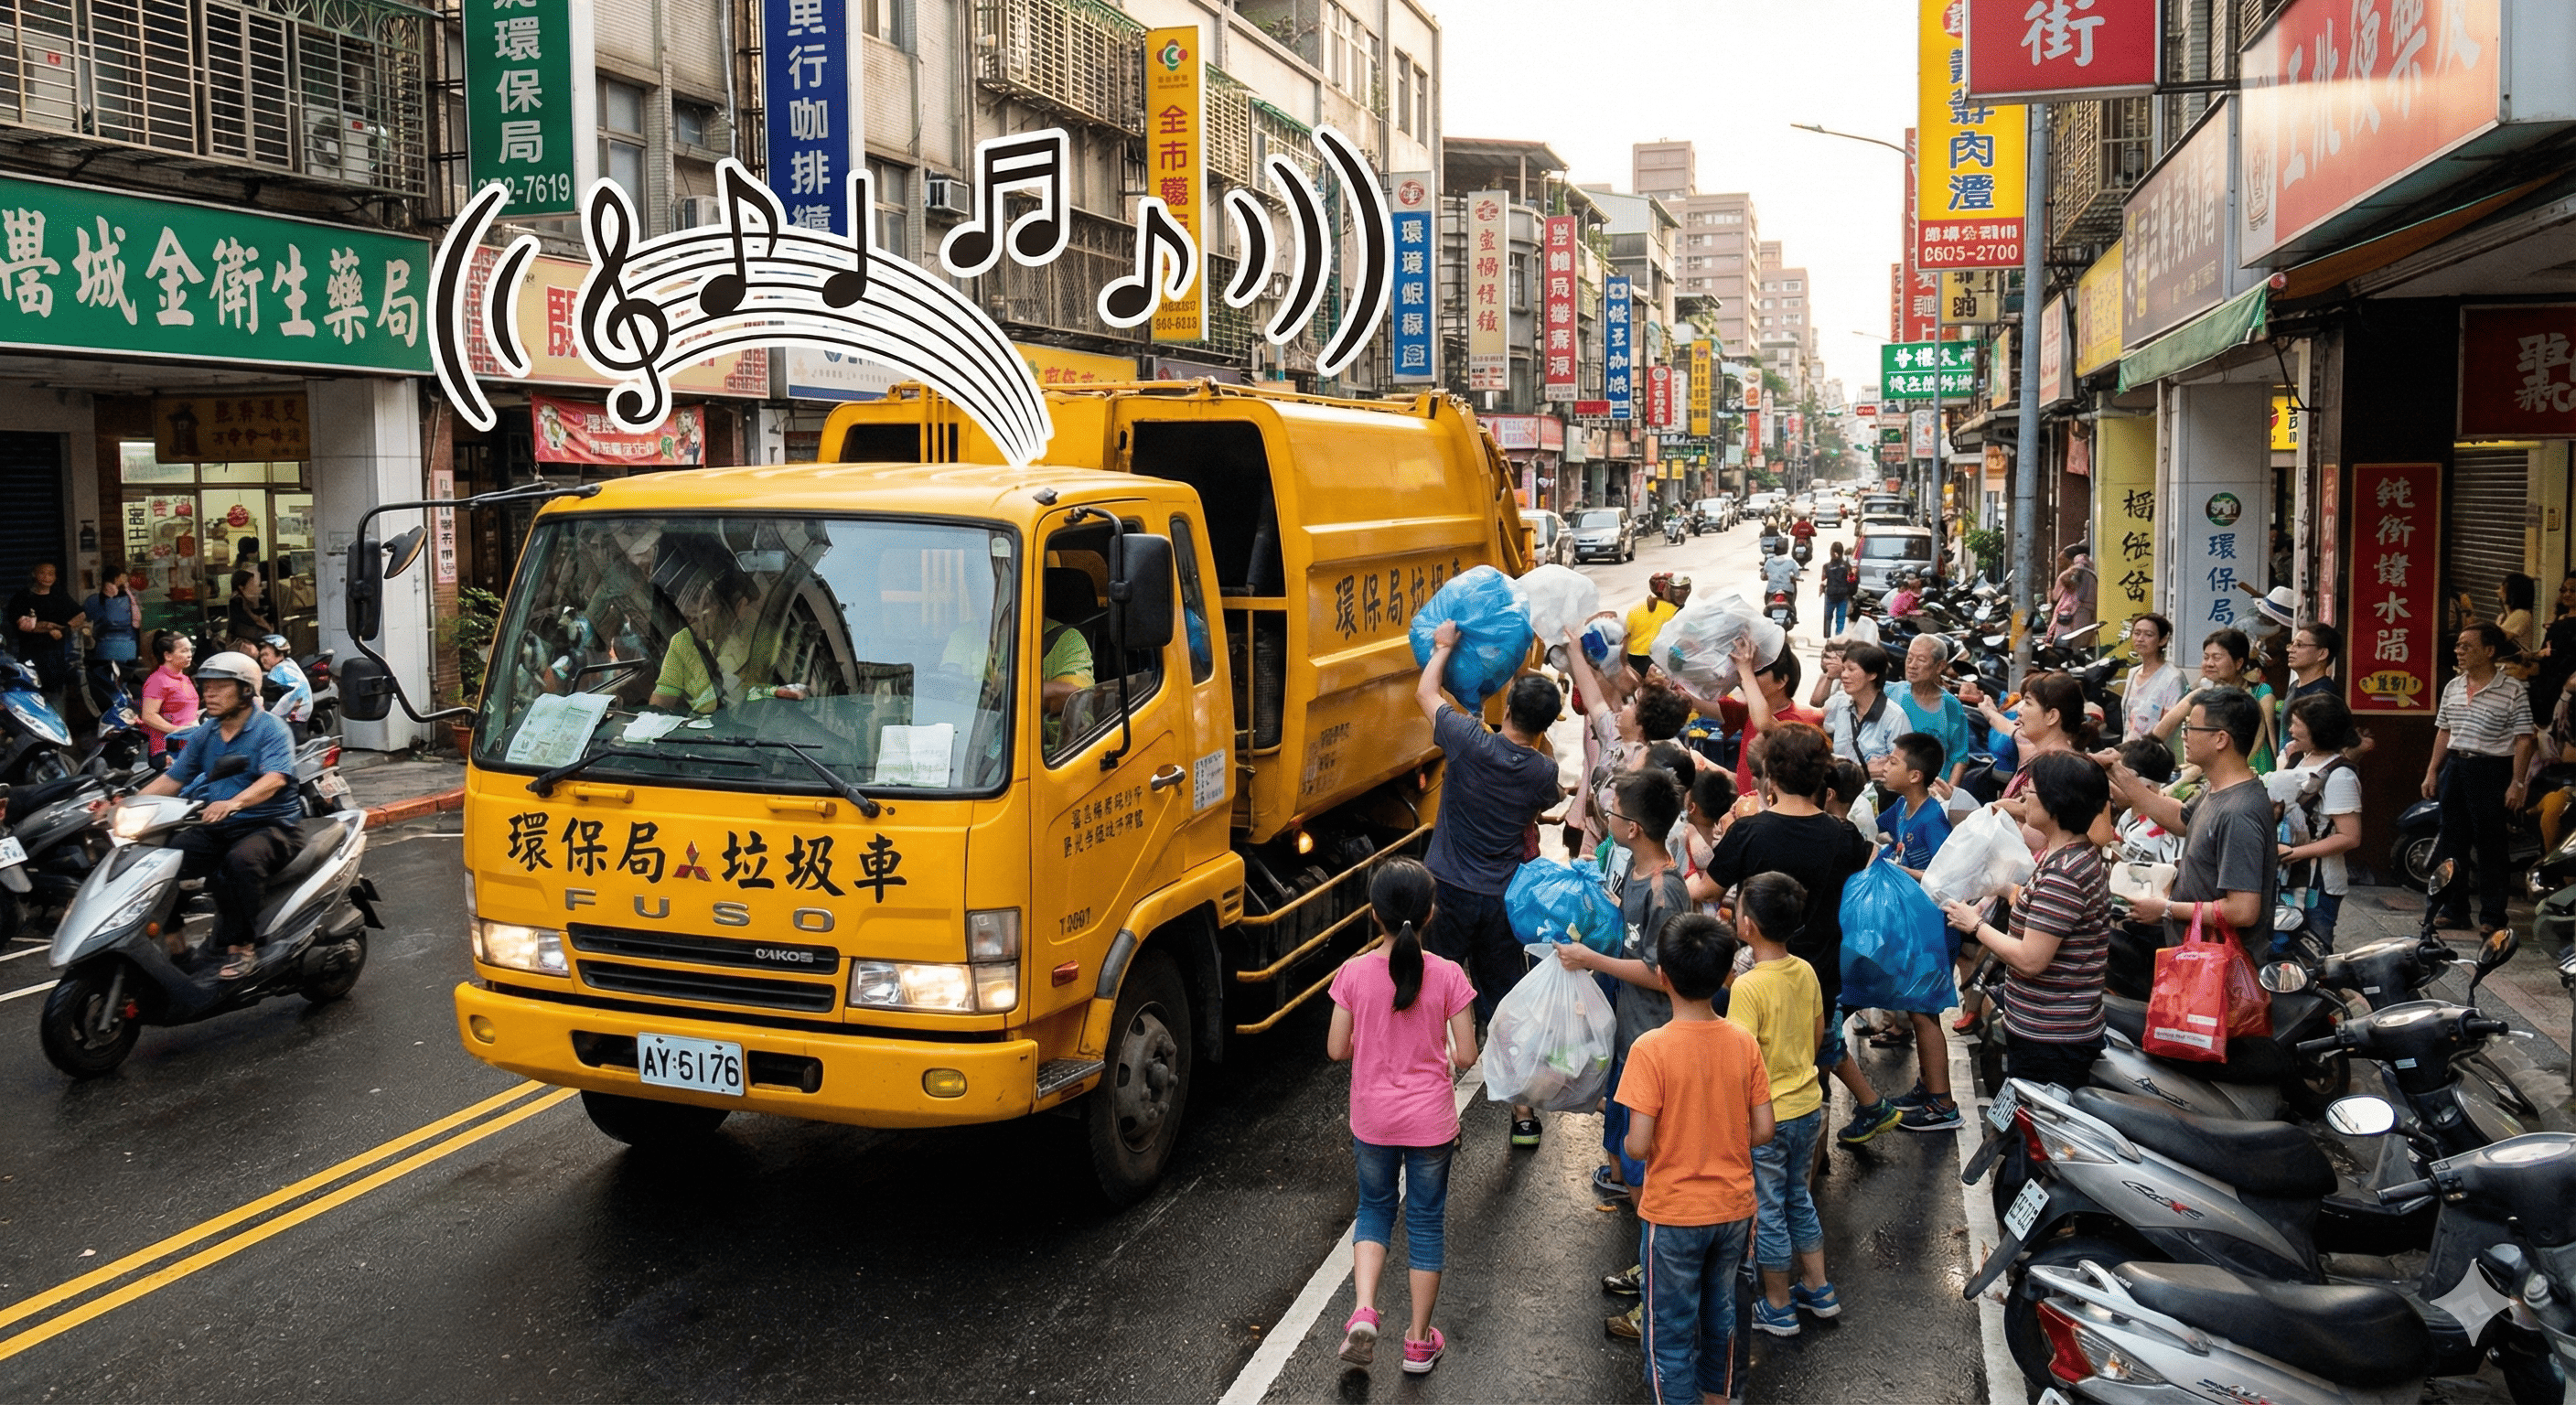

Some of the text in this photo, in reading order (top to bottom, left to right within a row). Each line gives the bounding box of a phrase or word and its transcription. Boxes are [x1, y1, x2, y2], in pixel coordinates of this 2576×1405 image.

[494, 0, 542, 164] 環保局
[2206, 533, 2238, 625] 環保局
[508, 811, 907, 904] 環保局 垃圾車
[565, 887, 835, 933] FUSO
